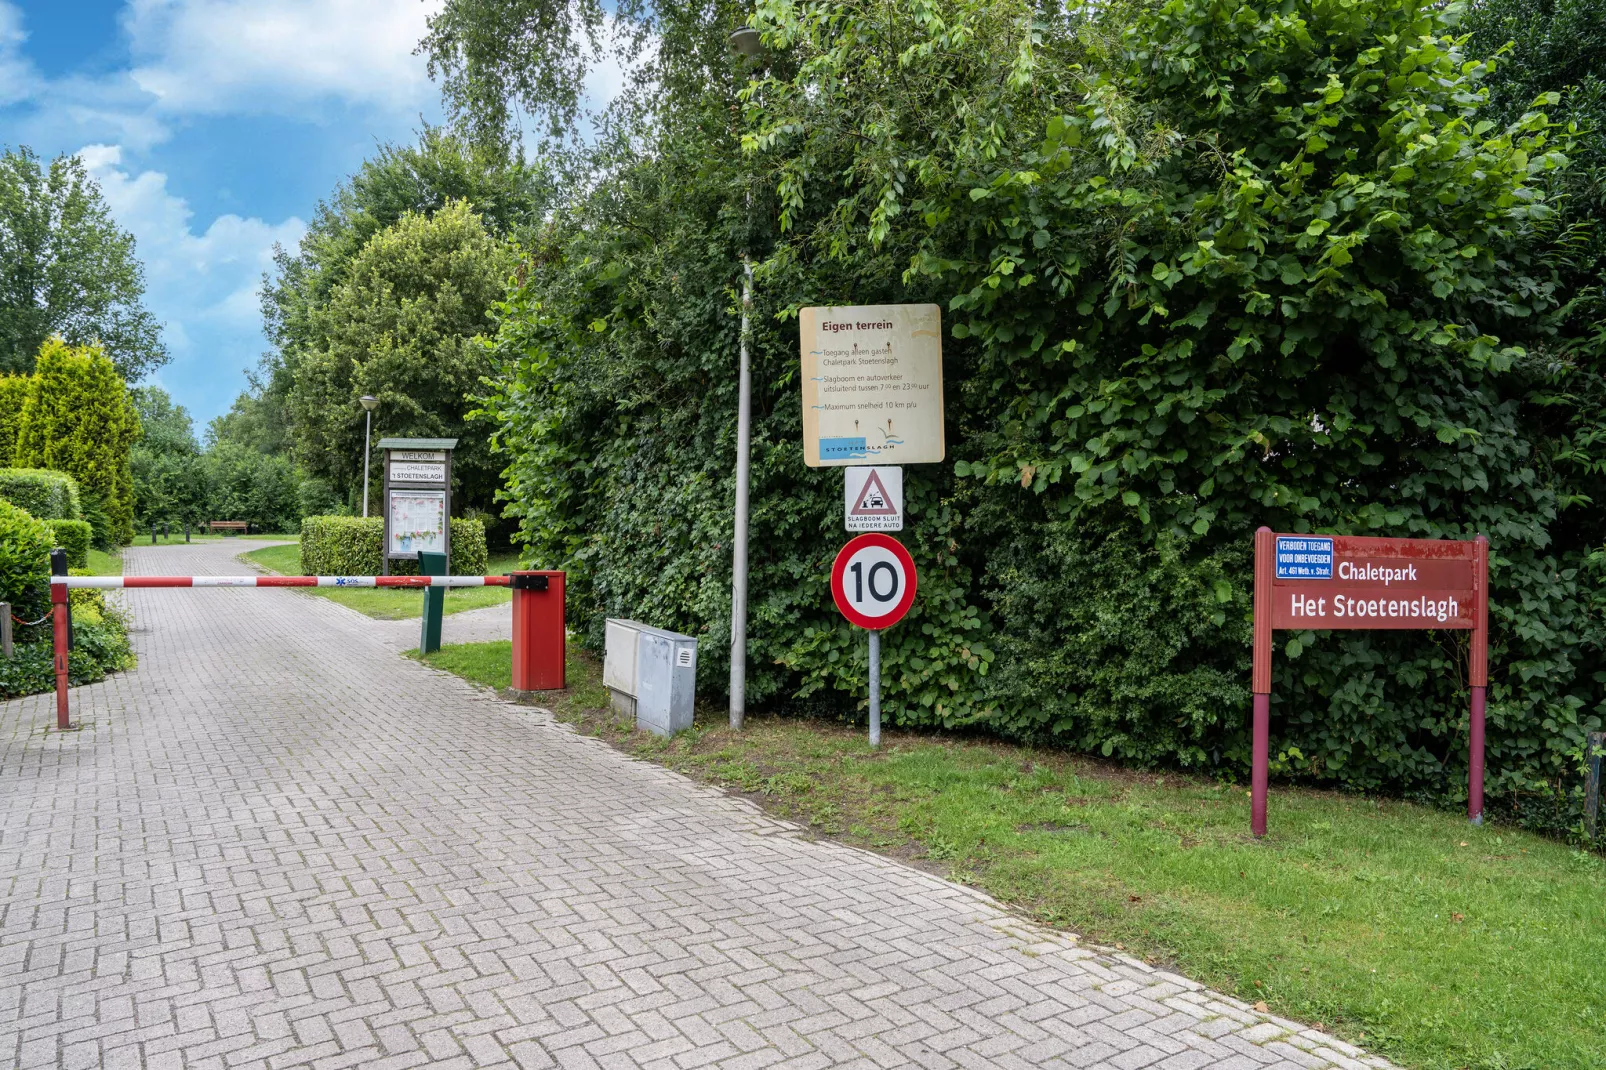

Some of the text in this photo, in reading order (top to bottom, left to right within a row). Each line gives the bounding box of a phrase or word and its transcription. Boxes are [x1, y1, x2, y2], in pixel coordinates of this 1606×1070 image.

[822, 320, 893, 333] Eigen terrein
[822, 349, 849, 357] Toegang
[872, 348, 892, 356] gasten
[823, 357, 898, 366] Chaletpark Stoetenslagh
[824, 375, 855, 384] Slagboom
[906, 402, 916, 410] p/u
[1279, 540, 1330, 551] VERBODEN TOEGANG
[1279, 554, 1330, 564] VOOR ONBEVOEGDEN
[1279, 566, 1288, 575] Art.
[1338, 562, 1417, 585] Chaletpark
[850, 561, 899, 602] 10
[1291, 594, 1458, 622] Het Stoetenslagh
